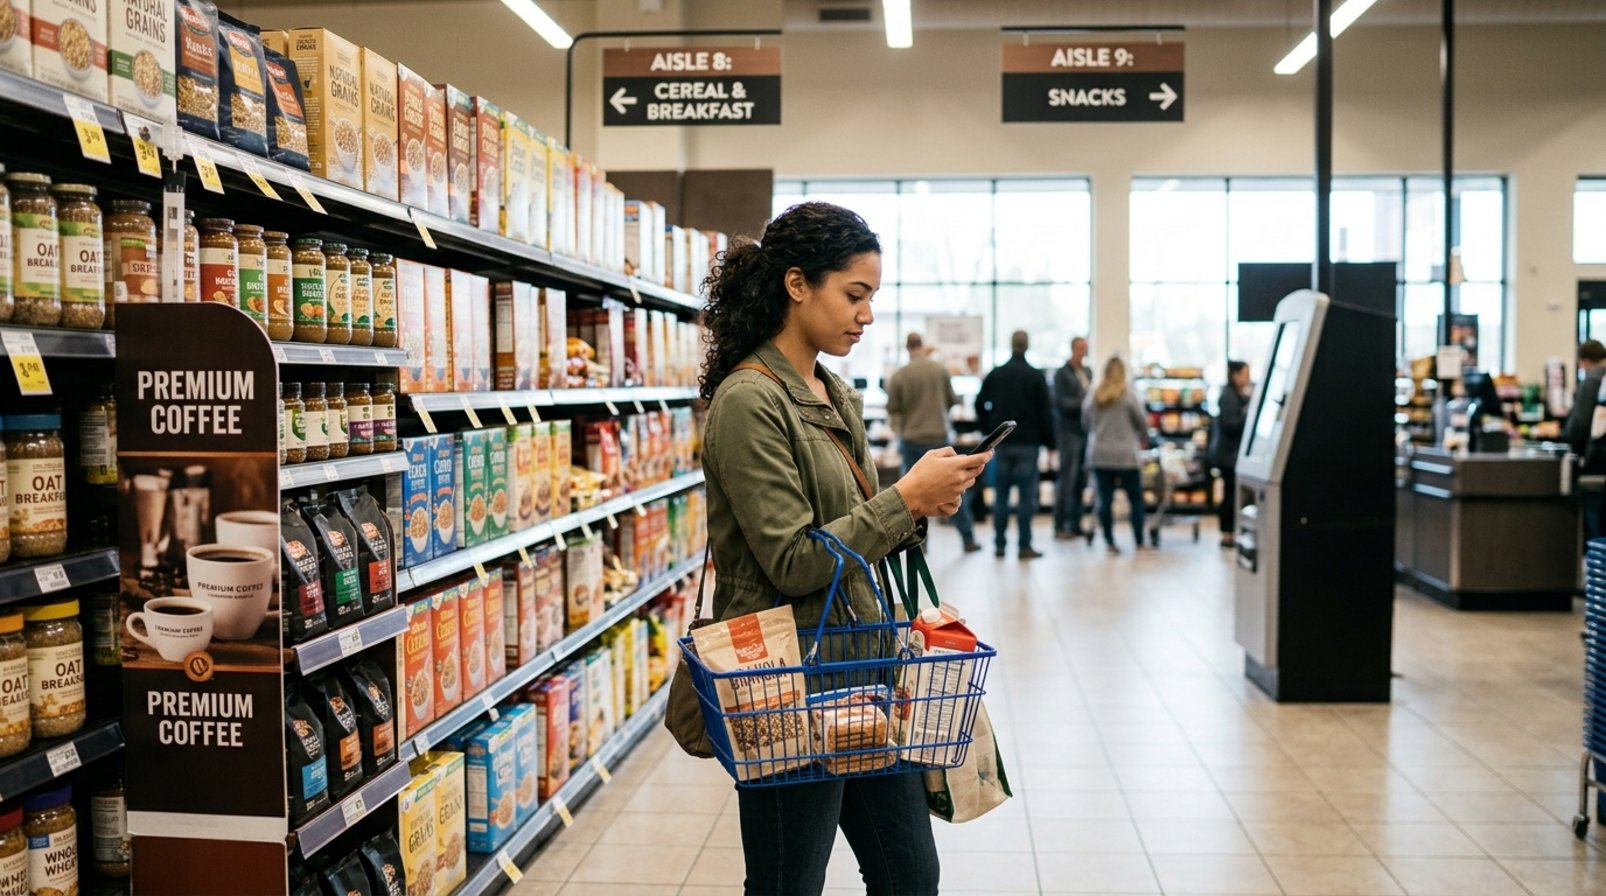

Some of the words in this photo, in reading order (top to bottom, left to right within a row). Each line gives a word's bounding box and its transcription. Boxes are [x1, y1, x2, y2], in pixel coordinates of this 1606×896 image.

[126, 8, 166, 43] GRAINS
[650, 52, 709, 71] AISLE
[712, 52, 732, 71] 8:
[1051, 48, 1110, 67] AISLE
[1114, 47, 1134, 67] 9:
[654, 82, 728, 99] CEREAL
[731, 81, 746, 99] &
[1048, 88, 1127, 107] SNACKS
[646, 102, 754, 120] BREAKFAST
[138, 371, 254, 400] PREMIUM
[151, 405, 242, 434] COFFEE
[32, 475, 62, 491] OAT
[55, 659, 81, 677] OAT
[2, 674, 28, 694] OAT
[147, 691, 253, 718] PREMIUM
[159, 720, 243, 747] COFFEE
